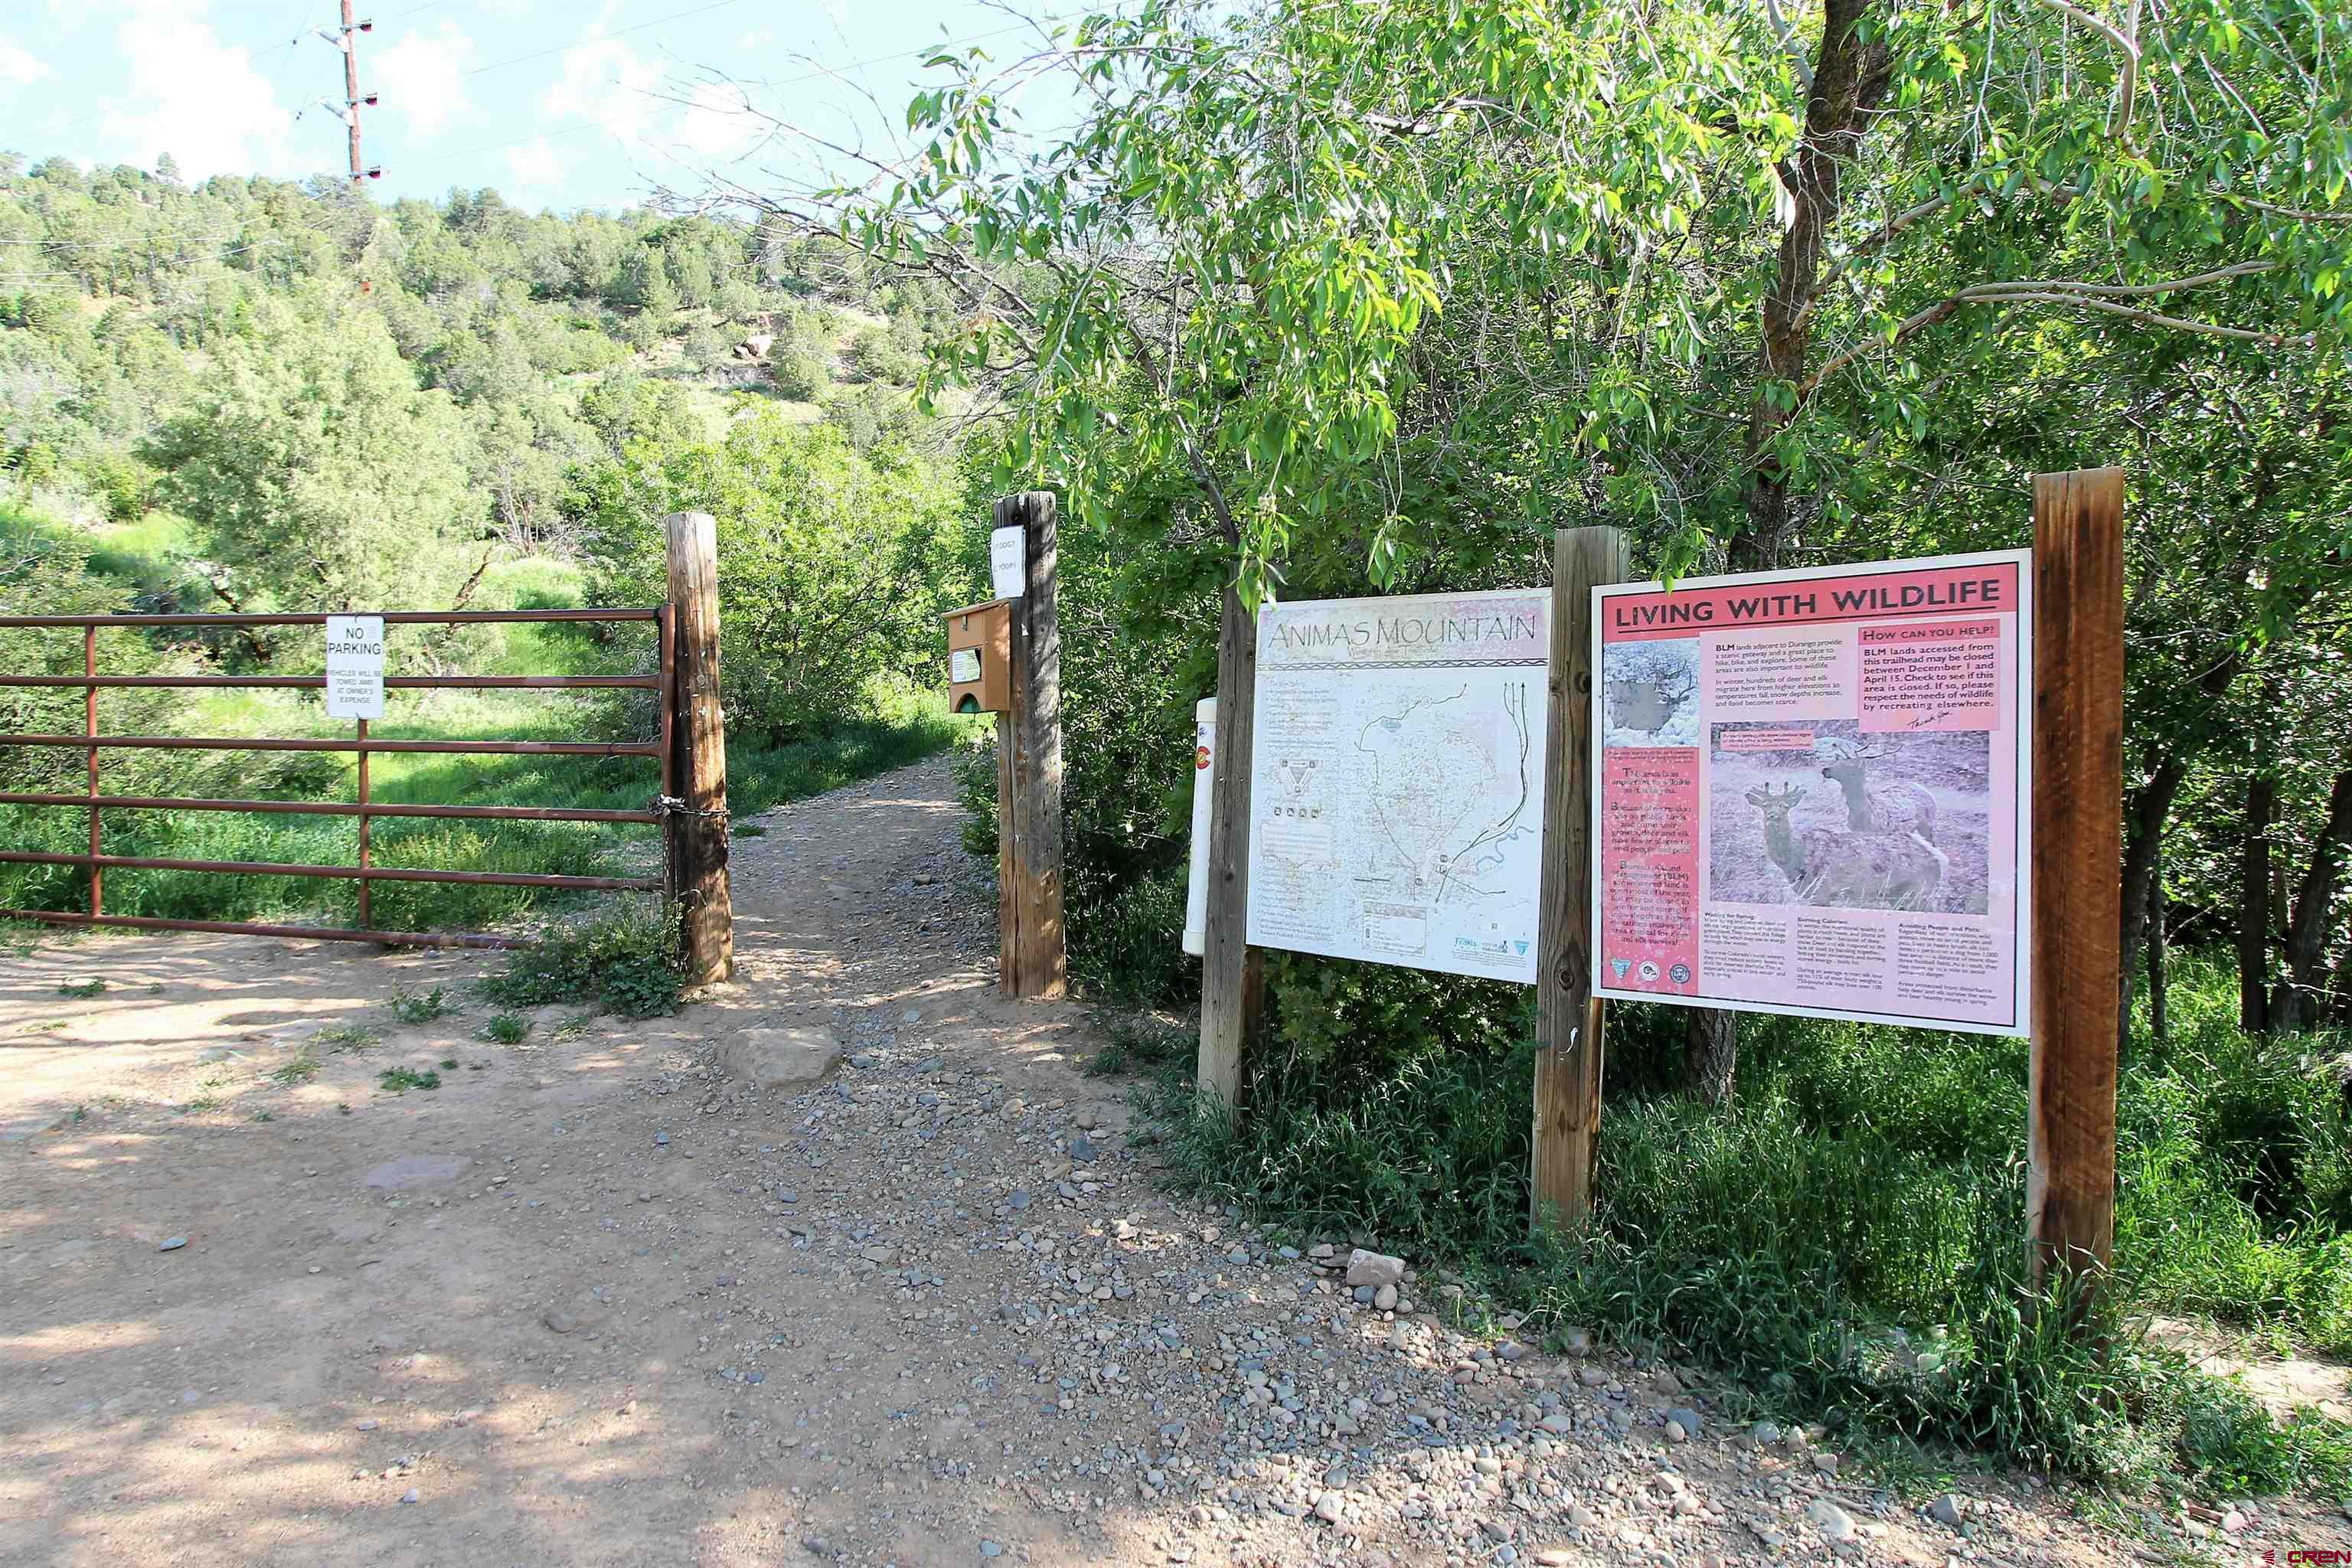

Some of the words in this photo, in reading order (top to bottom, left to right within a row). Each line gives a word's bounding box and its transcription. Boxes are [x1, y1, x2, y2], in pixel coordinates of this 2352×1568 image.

[1615, 601, 1713, 626] LIVING
[1727, 593, 1816, 619] WITH
[1831, 579, 2000, 612] WILDLIFE
[346, 628, 364, 639] NO
[1268, 622, 1370, 648] ANIMAS
[1377, 615, 1535, 644] MOUNTAIN
[1901, 630, 1926, 639] CAN
[1960, 626, 1994, 635] HELP?
[328, 643, 381, 655] PARKING
[1919, 645, 1964, 653] accessed
[1883, 655, 1923, 664] trailhead
[1864, 676, 1886, 684] April
[1775, 683, 1795, 691] higher
[1962, 681, 1993, 690] please
[1880, 701, 1932, 710] recreating
